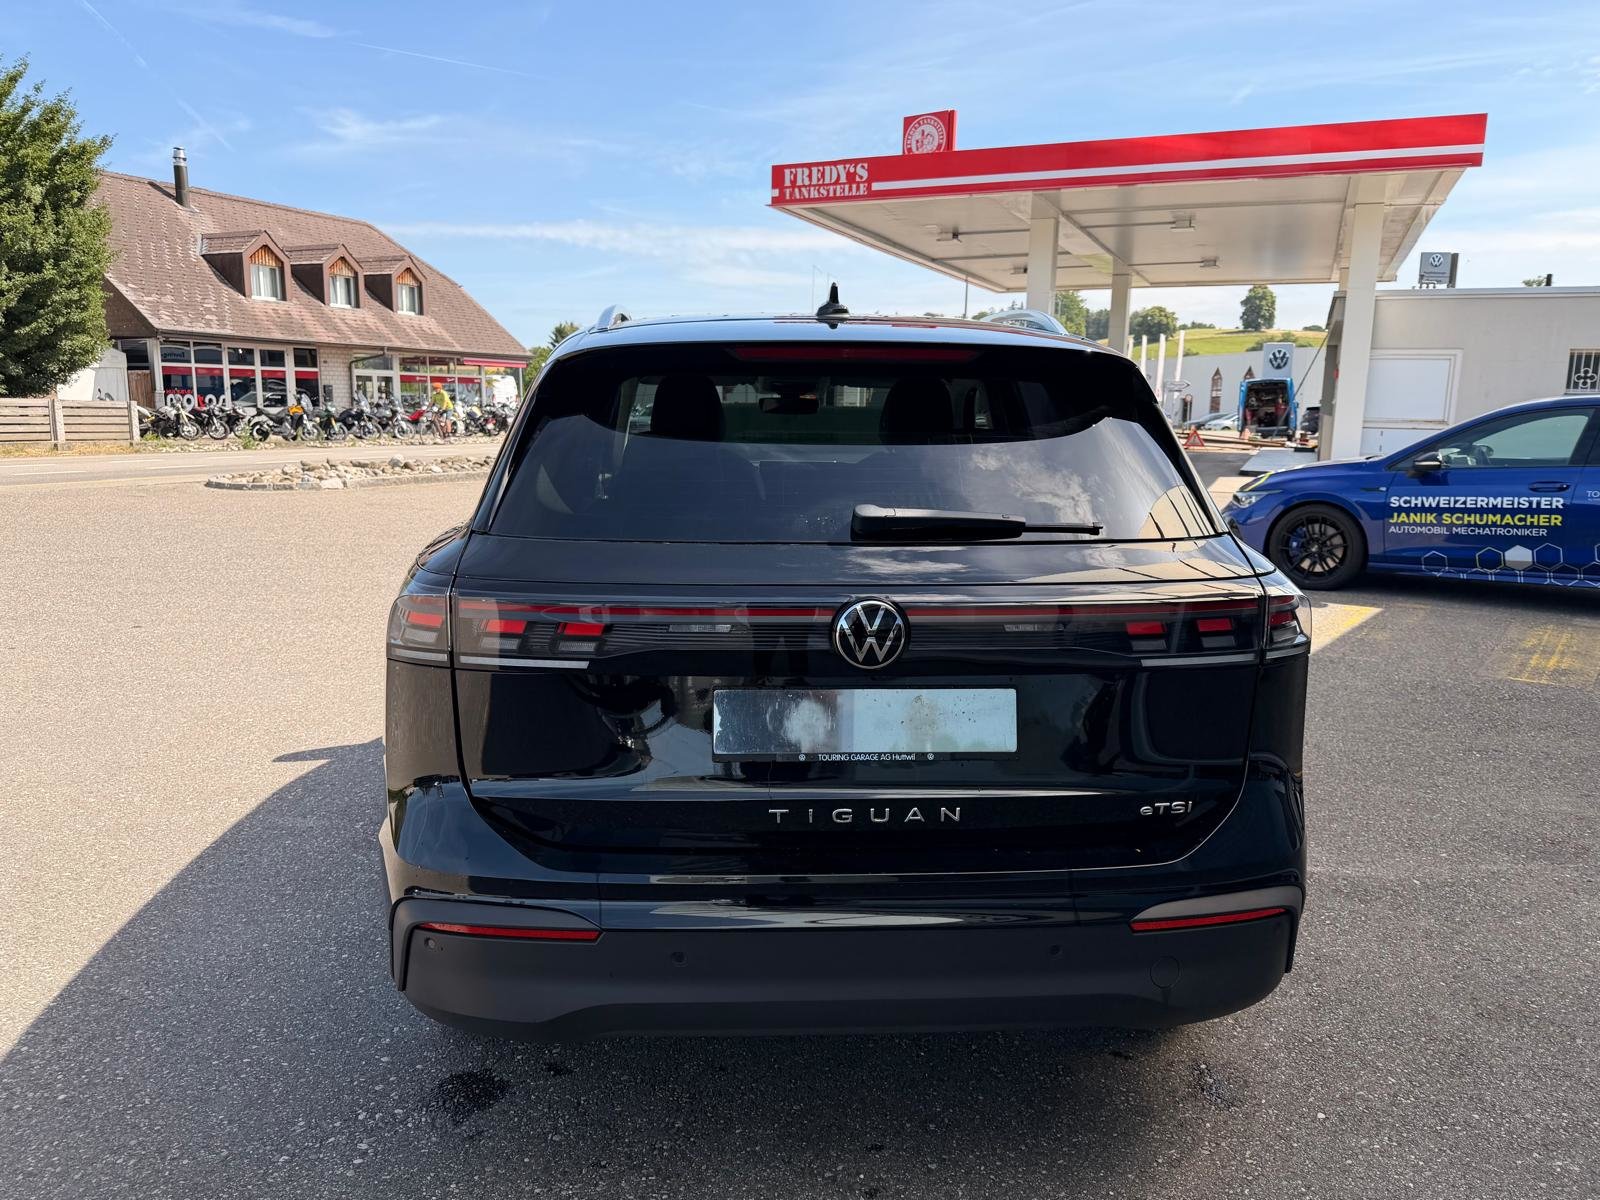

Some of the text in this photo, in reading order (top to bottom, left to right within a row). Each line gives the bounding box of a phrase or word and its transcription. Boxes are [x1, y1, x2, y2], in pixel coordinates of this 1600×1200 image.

[784, 163, 869, 187] FREDY'S
[784, 183, 868, 200] TANKSTELLE
[1389, 496, 1564, 509] SCHWEIZERMEISTER
[1389, 512, 1563, 526] JANIK SCHUMACHER
[1388, 525, 1548, 537] AUTOMOBIL MECHATRONIKER
[818, 753, 850, 762] TOURING
[850, 753, 879, 761] GARAGE
[880, 753, 891, 761] AG
[769, 806, 961, 824] TIGUAN
